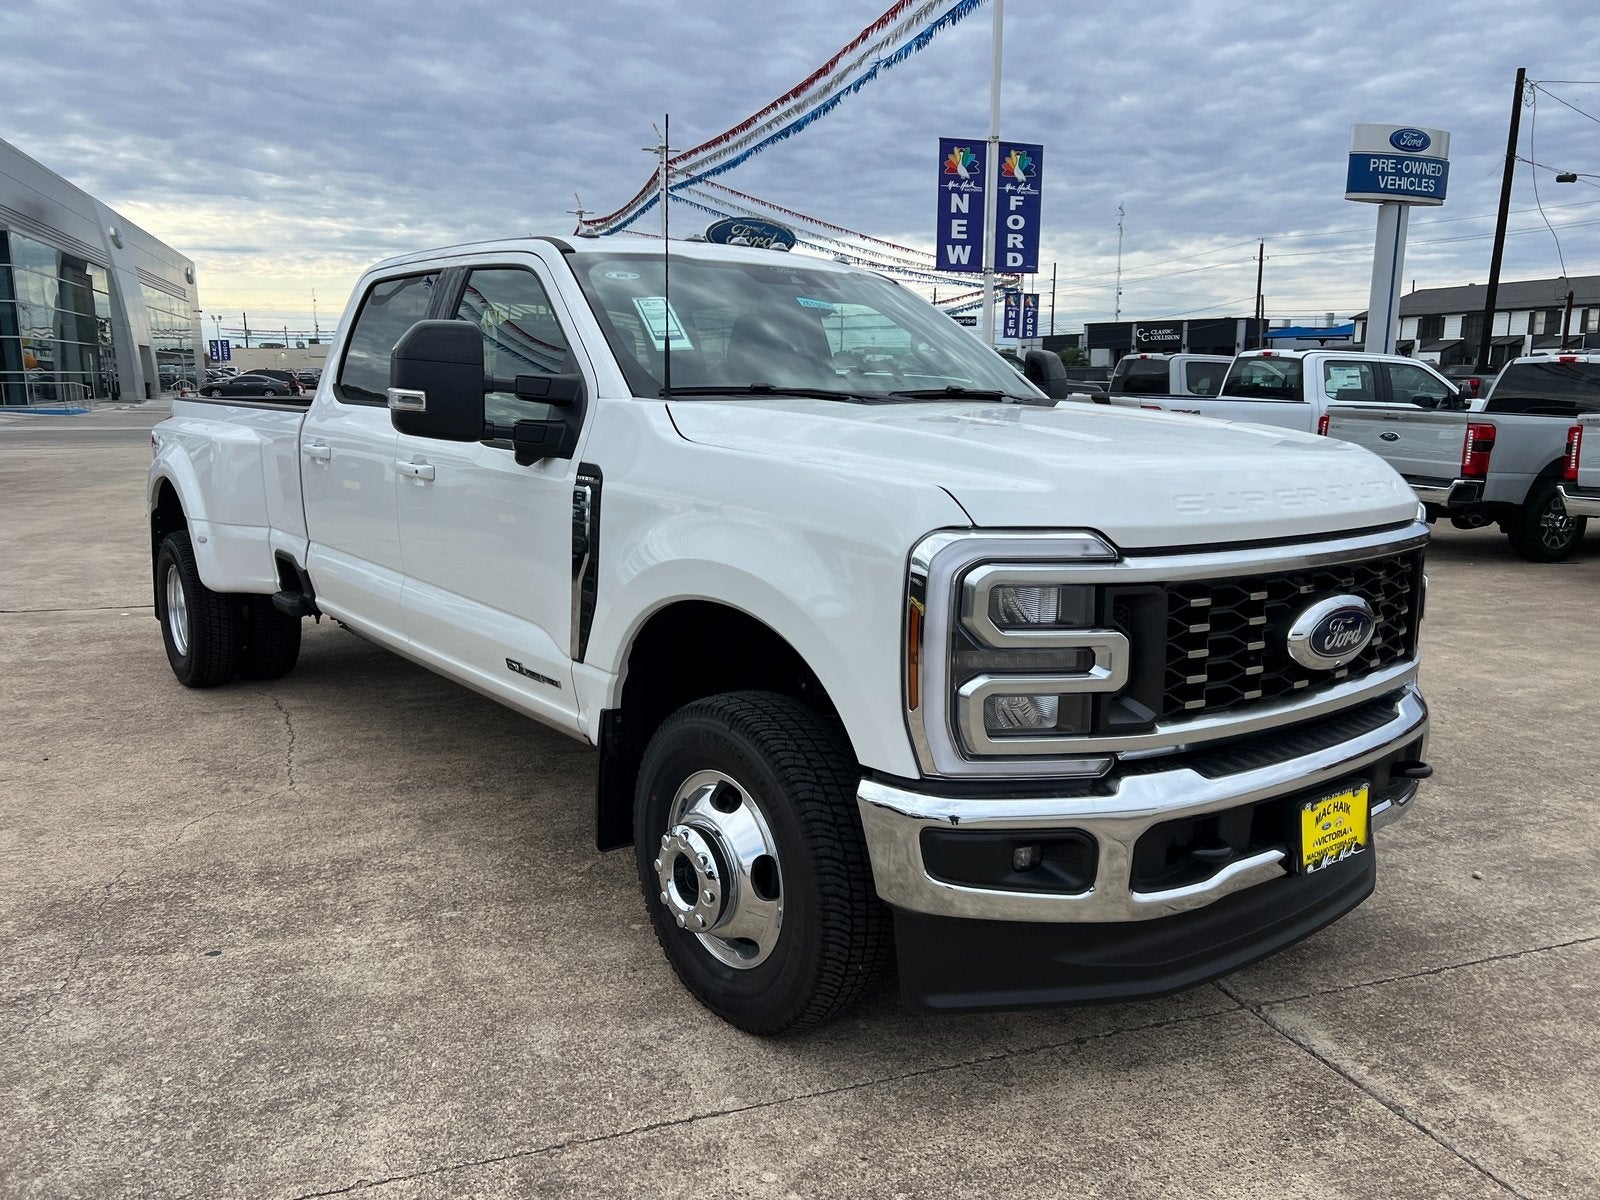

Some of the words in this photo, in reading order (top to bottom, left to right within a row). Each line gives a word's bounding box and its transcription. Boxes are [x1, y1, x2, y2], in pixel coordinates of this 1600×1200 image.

[1400, 132, 1423, 147] Ford
[1378, 175, 1435, 192] VEHICLES
[946, 193, 971, 265] NEW
[1006, 195, 1025, 267] FORD
[1007, 310, 1016, 336] NEW
[1172, 487, 1329, 515] SUPER
[1324, 616, 1363, 650] Ford
[1314, 804, 1332, 828] MAC
[1333, 801, 1351, 816] HAIK
